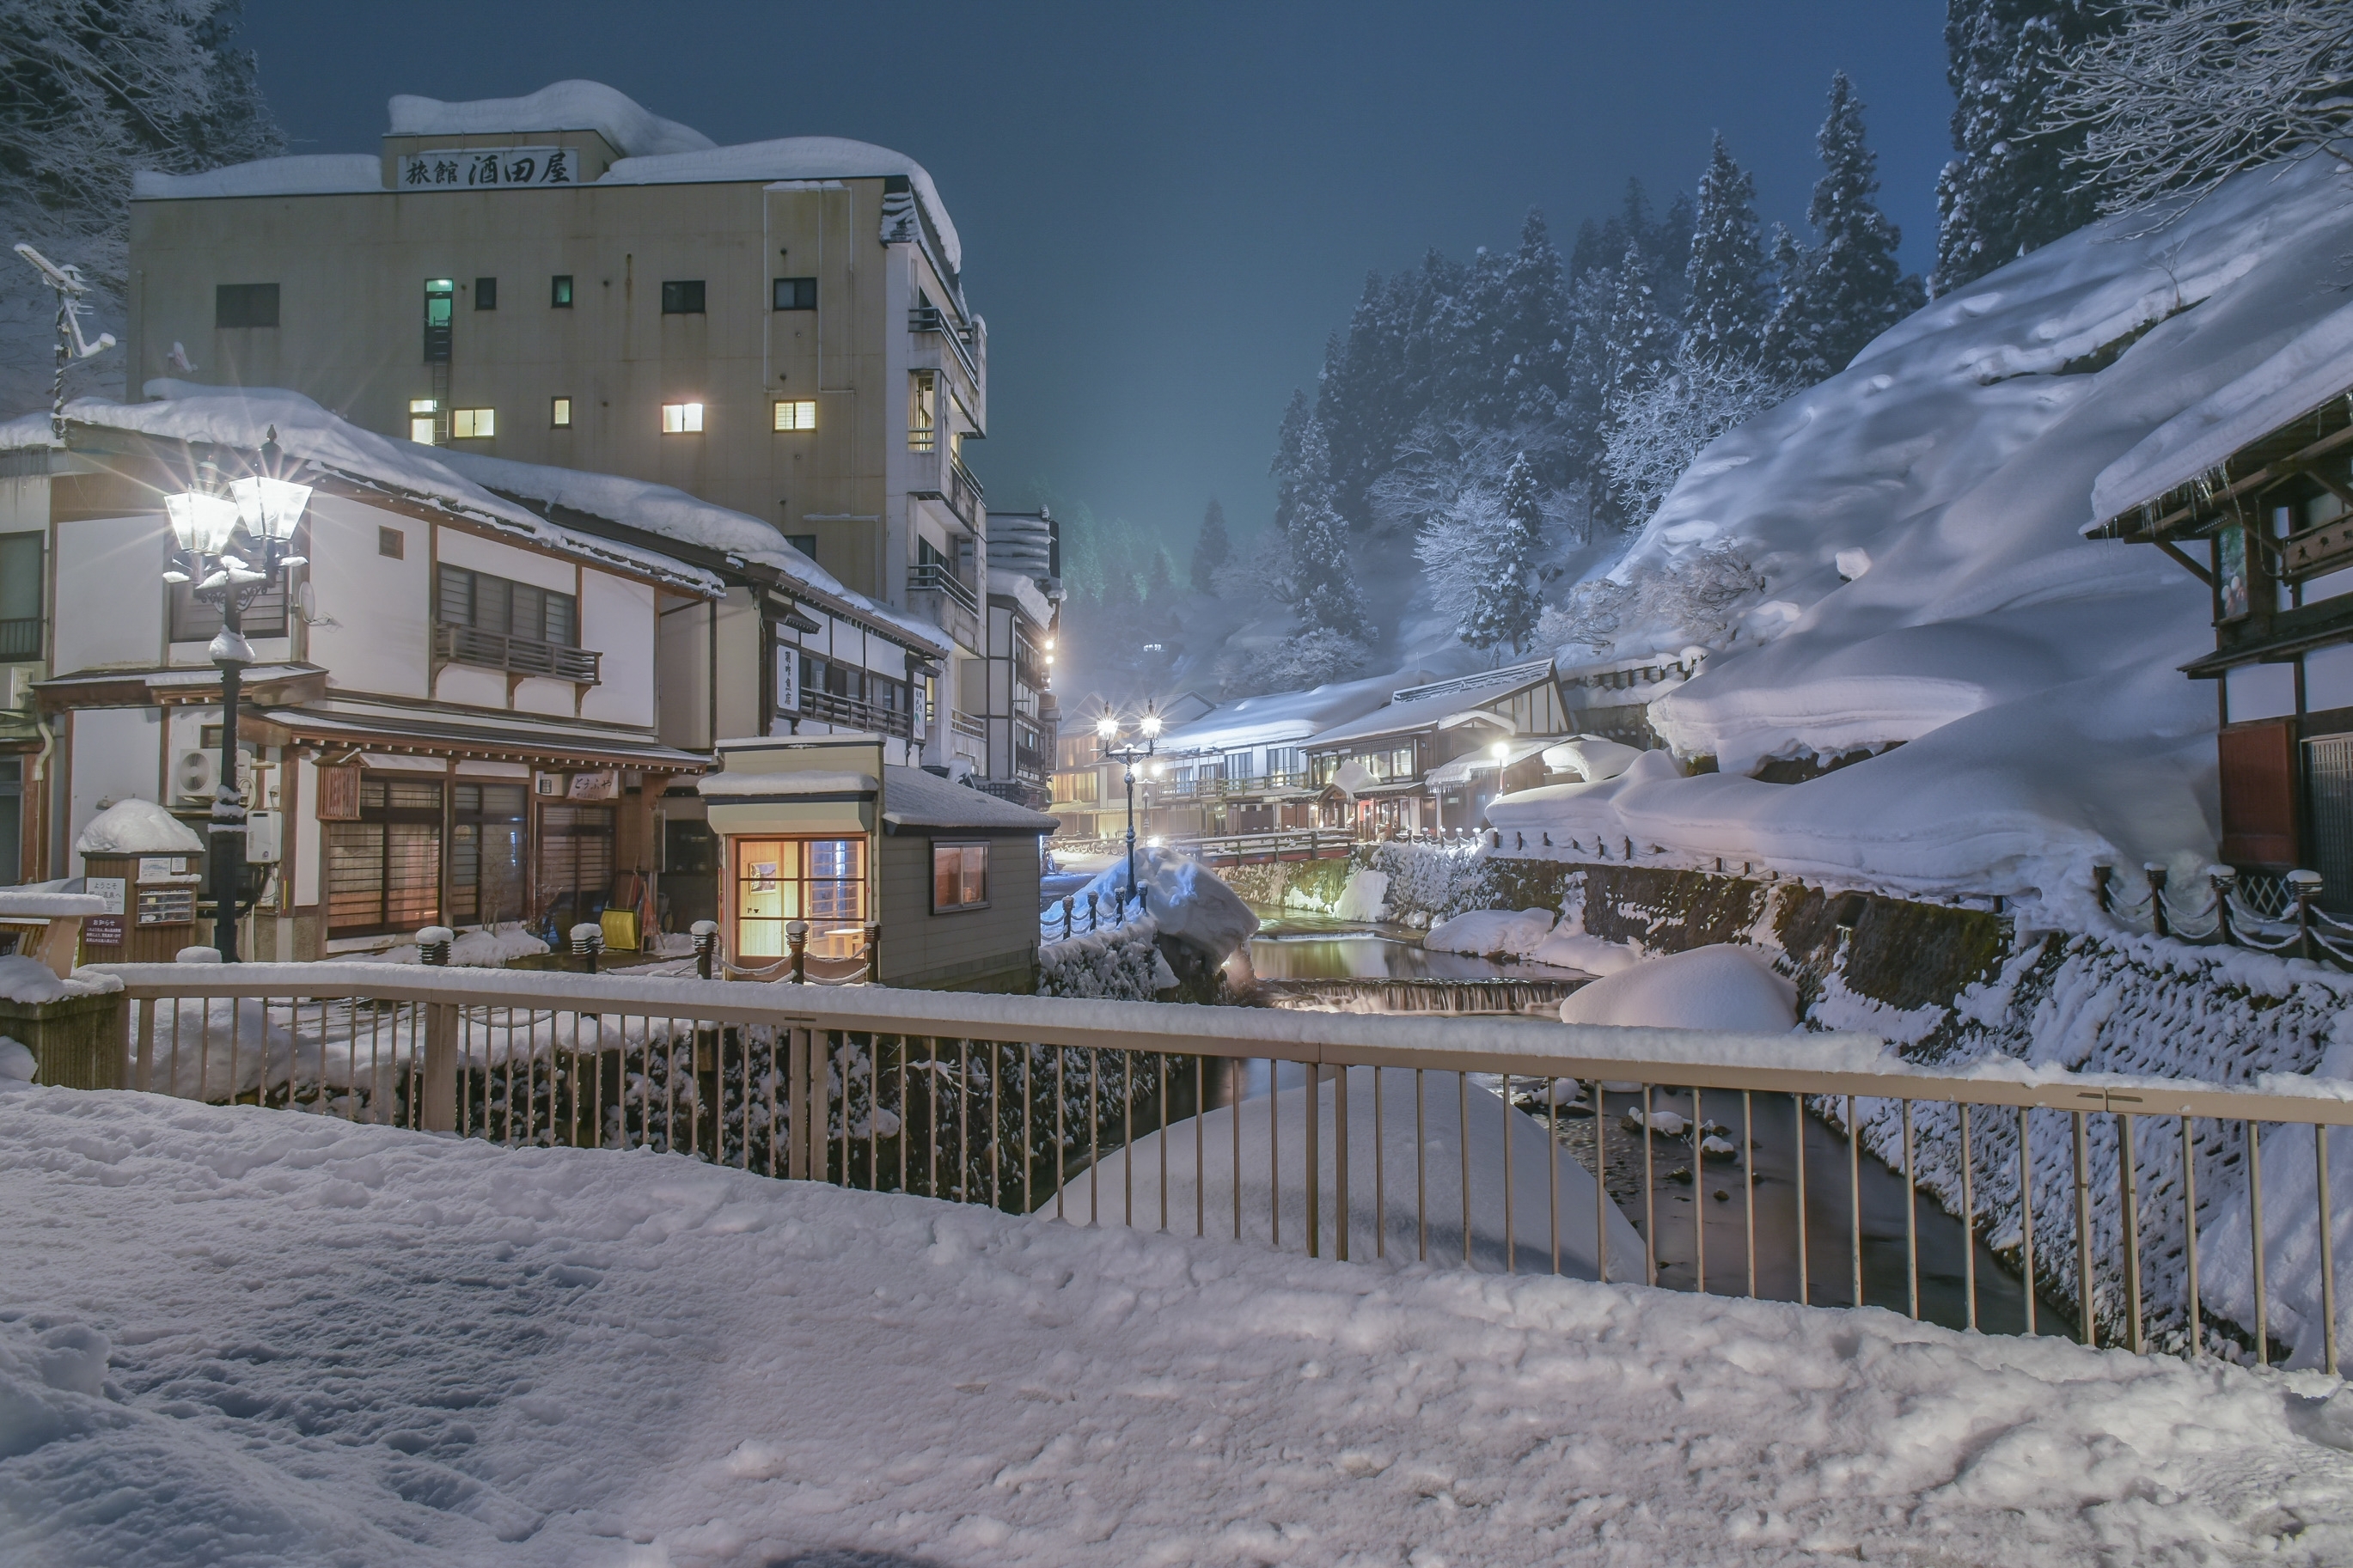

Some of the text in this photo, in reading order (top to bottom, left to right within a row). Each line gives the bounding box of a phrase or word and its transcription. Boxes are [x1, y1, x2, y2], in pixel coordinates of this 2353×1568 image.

[575, 778, 612, 790] とうふや
[95, 882, 117, 890] ようこそ
